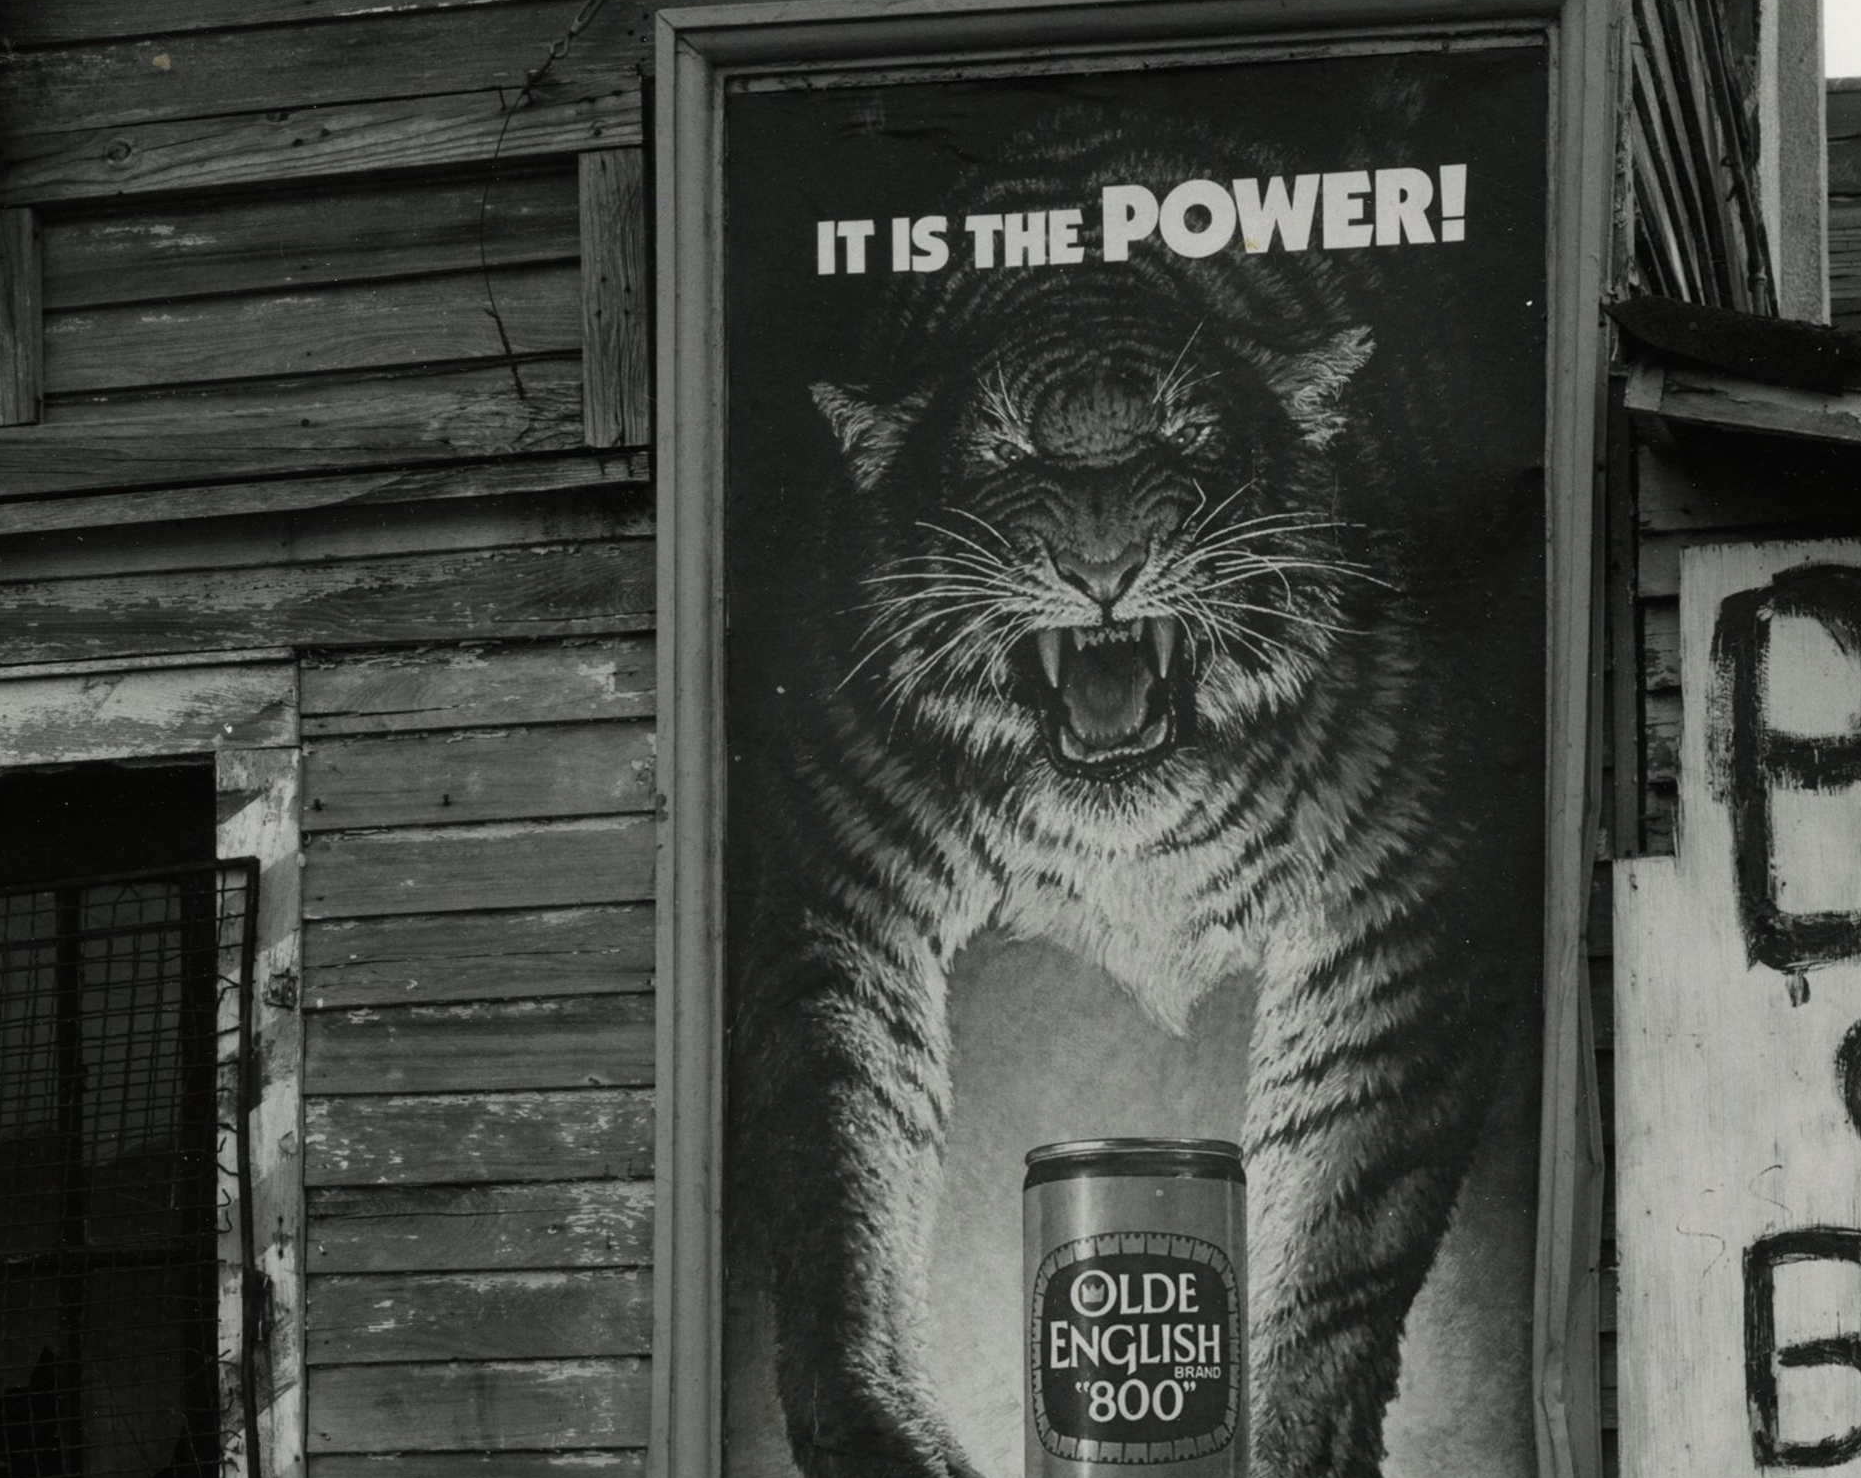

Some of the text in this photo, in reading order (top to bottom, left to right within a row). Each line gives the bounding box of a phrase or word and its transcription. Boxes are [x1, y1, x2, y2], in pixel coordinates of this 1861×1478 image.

[816, 163, 1467, 276] IT IS THE POWER!
[1070, 1269, 1200, 1318] OLDE
[1049, 1320, 1222, 1376] ENGLISH
[1173, 1365, 1222, 1379] BRAND
[1074, 1378, 1197, 1423] "800"
